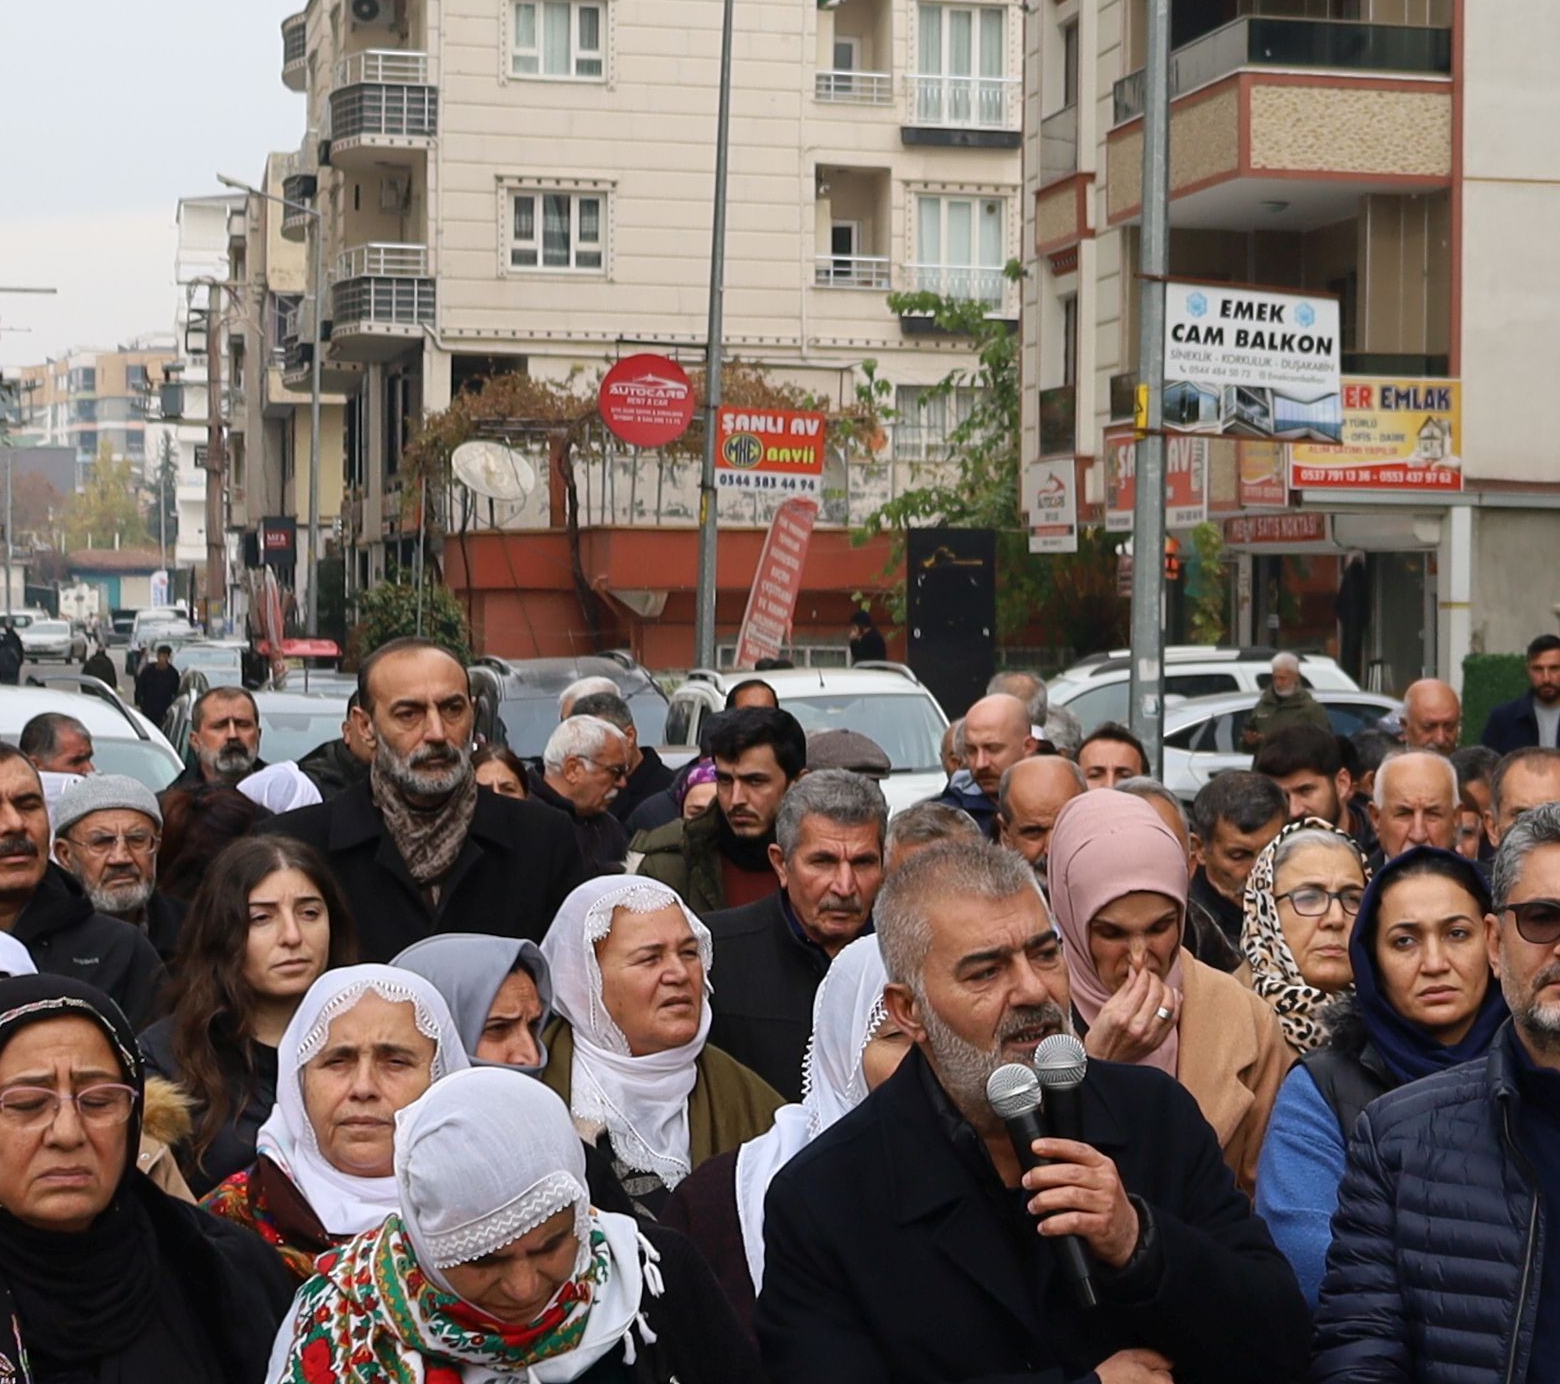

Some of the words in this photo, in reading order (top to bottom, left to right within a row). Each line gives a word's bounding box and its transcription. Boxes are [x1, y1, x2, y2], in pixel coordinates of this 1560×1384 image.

[1219, 299, 1286, 324] EMEK
[1171, 323, 1224, 346] CAM
[1234, 329, 1334, 356] BALKON
[609, 386, 686, 400] AUTOCARS
[1381, 386, 1452, 411] EMLAK
[722, 413, 784, 436] ŞANLI
[790, 418, 820, 436] AV
[781, 478, 796, 490] 44
